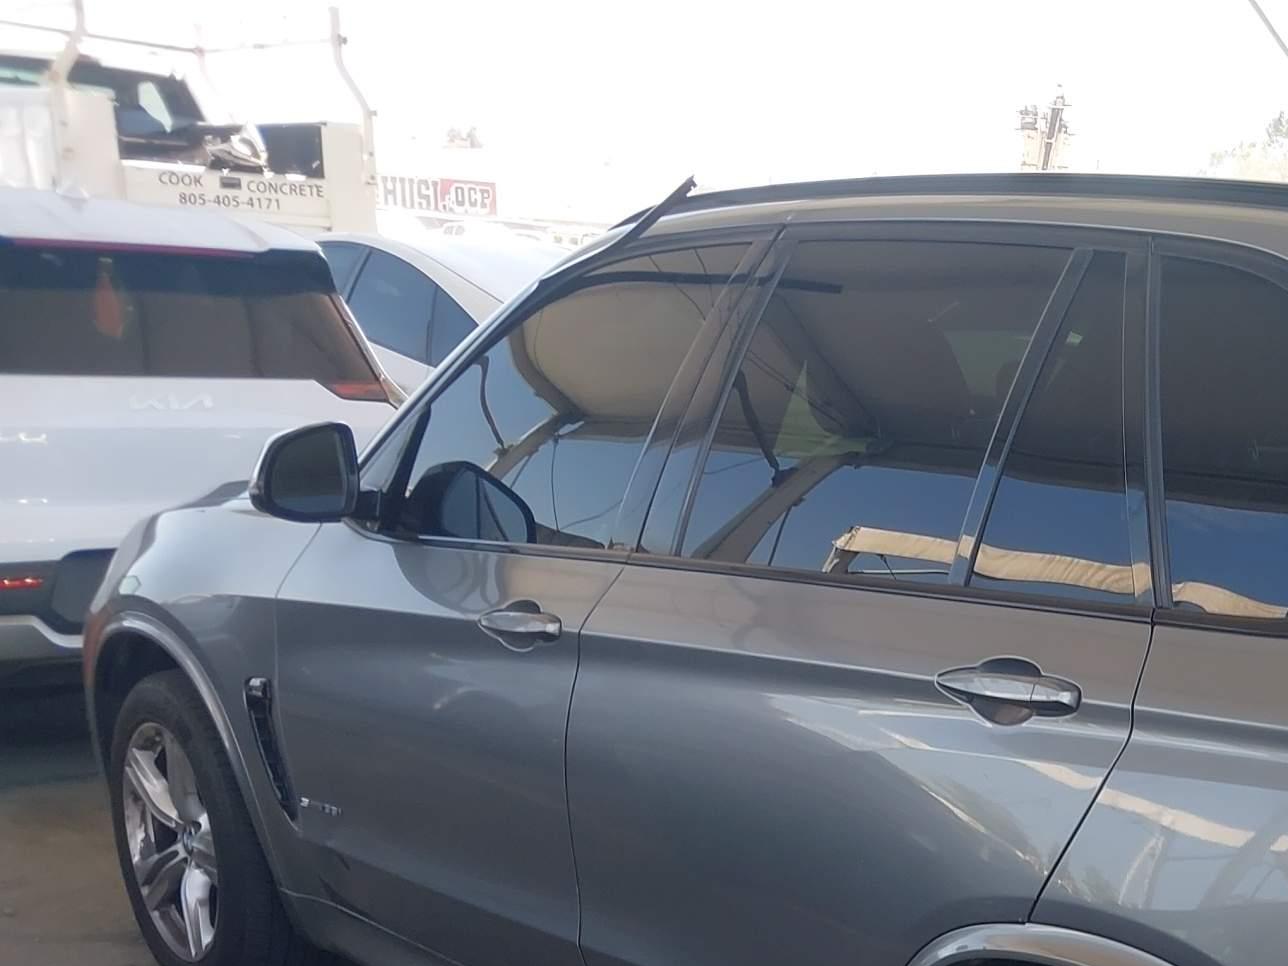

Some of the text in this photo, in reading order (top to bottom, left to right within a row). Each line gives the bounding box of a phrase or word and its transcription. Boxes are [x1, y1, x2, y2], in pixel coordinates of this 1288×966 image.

[159, 170, 324, 198] COOK CONCRETE
[178, 191, 281, 211] 805-405-4171
